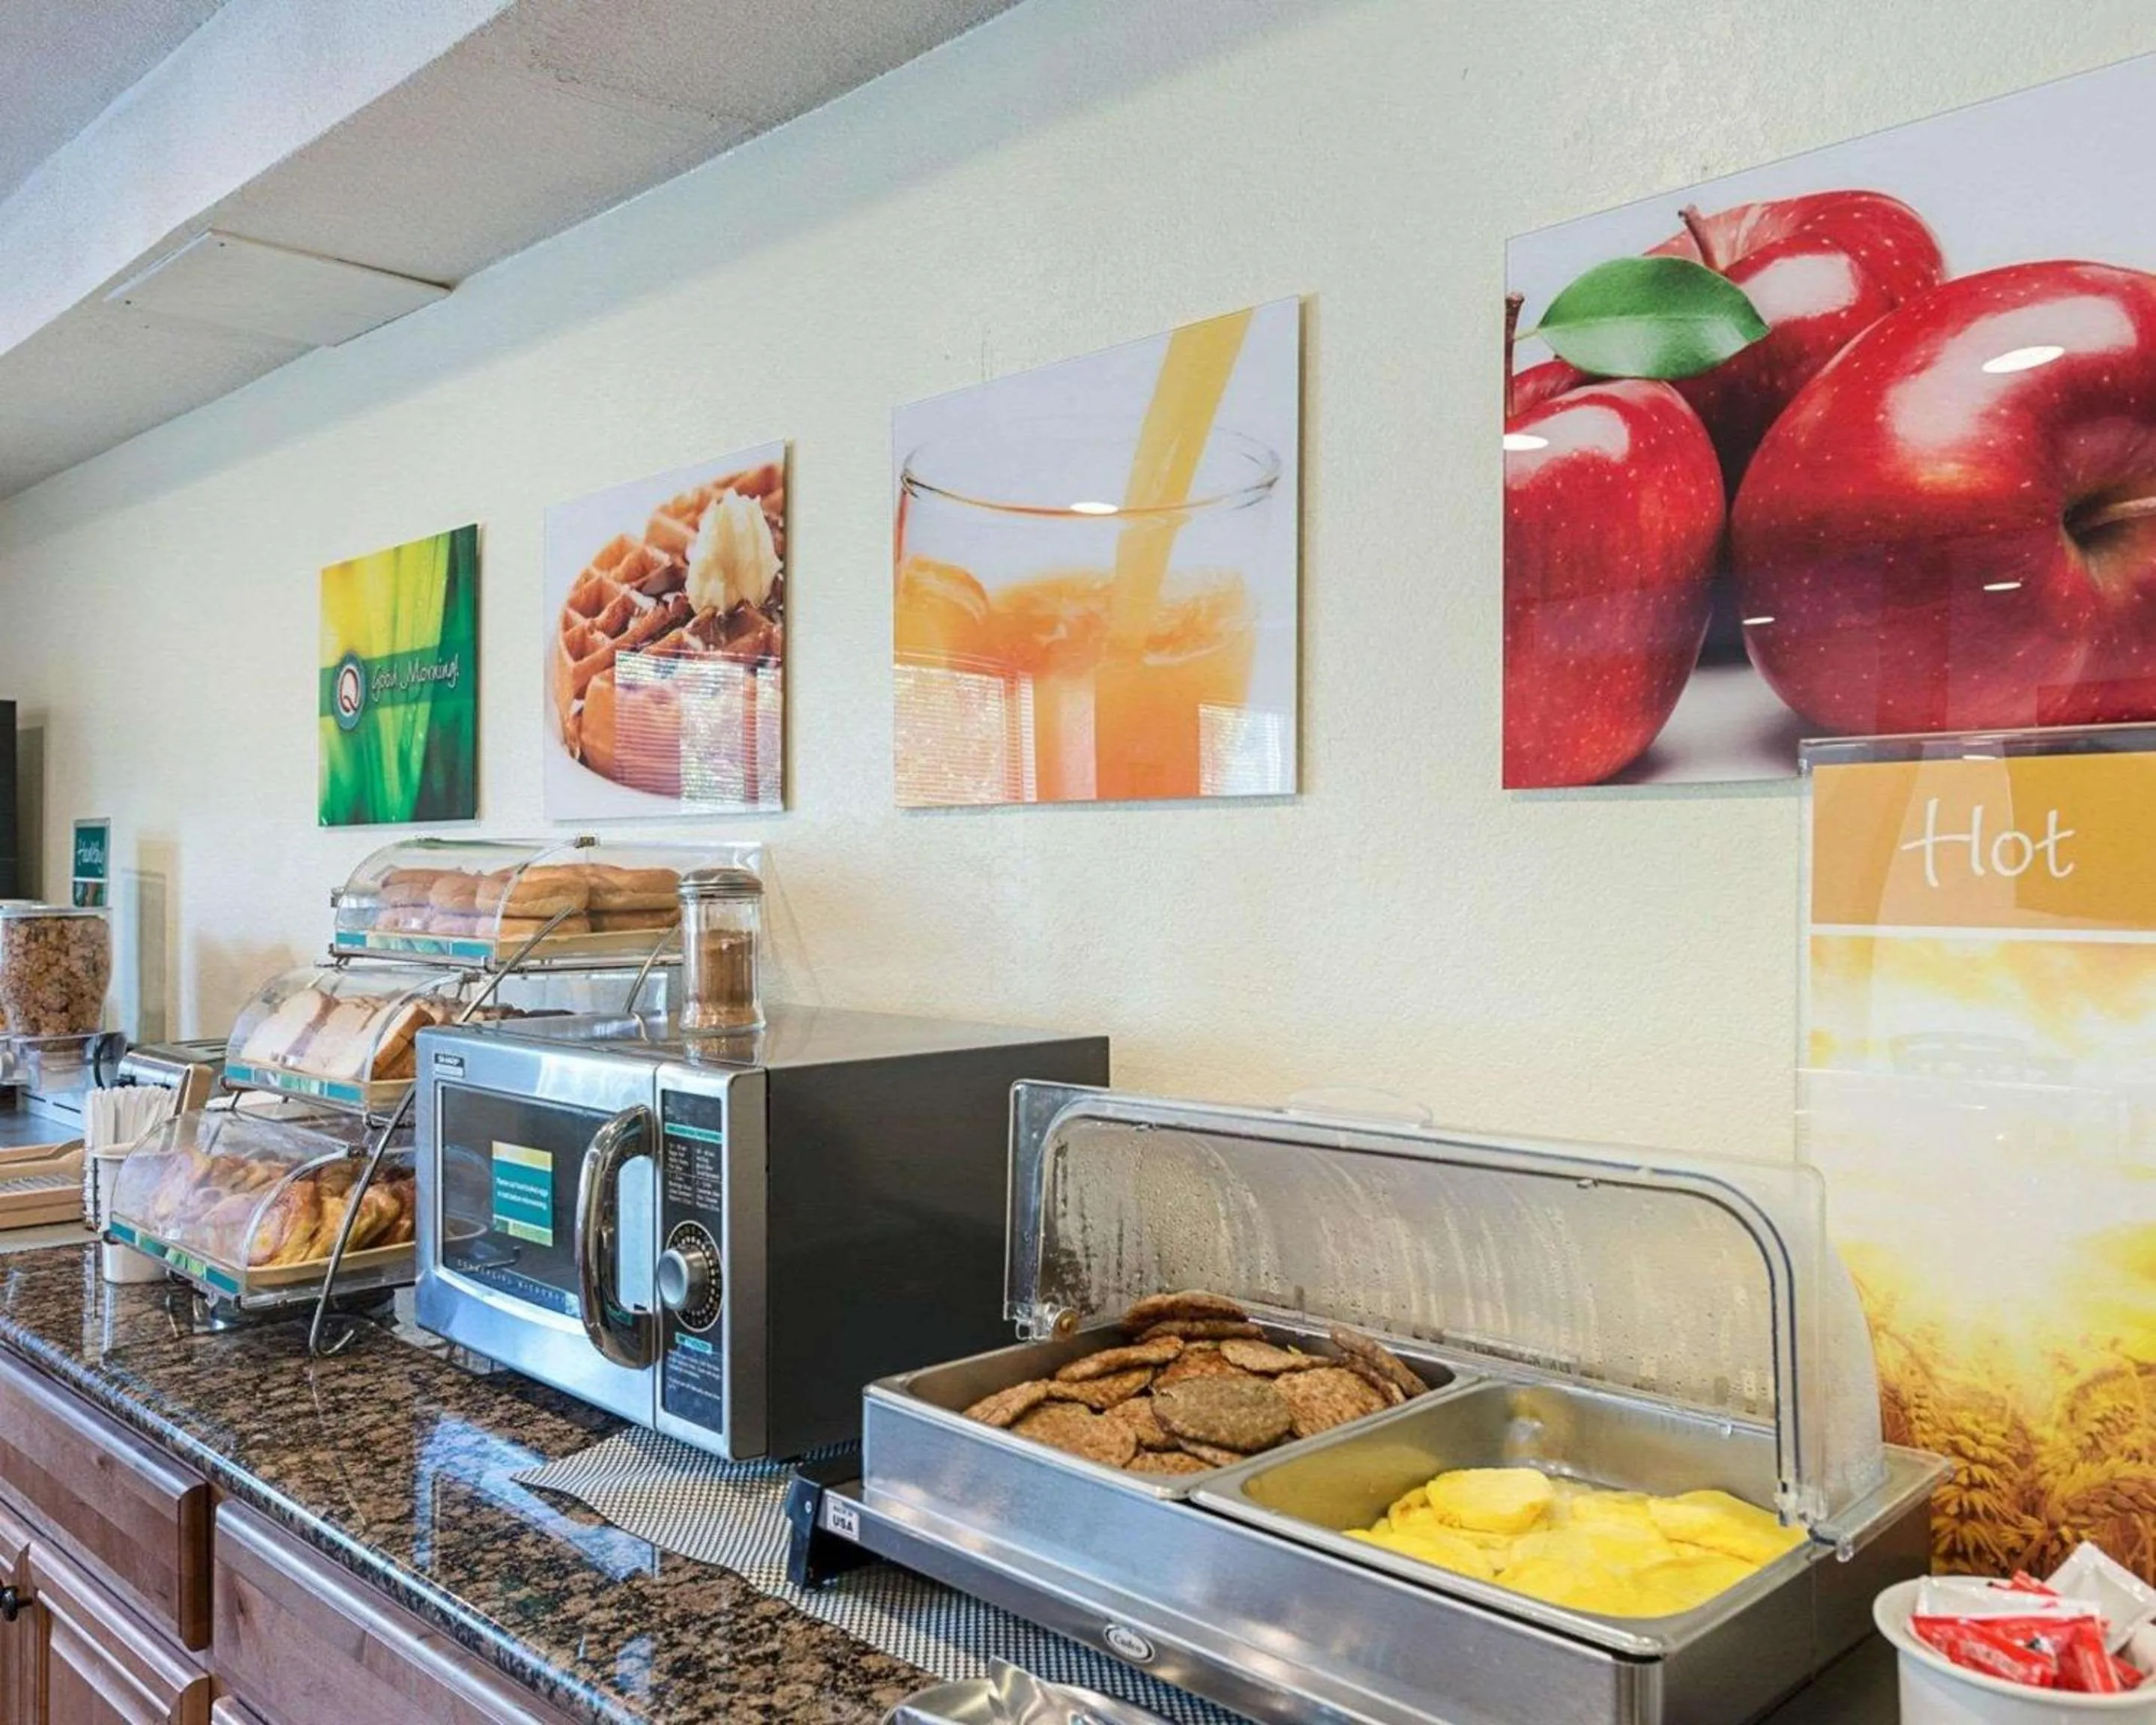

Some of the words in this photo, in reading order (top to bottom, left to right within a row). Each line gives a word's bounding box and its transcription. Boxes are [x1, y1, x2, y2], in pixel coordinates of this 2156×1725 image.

[339, 667, 359, 714] Q
[1899, 797, 2076, 887] Hot
[832, 1513, 853, 1533] USA
